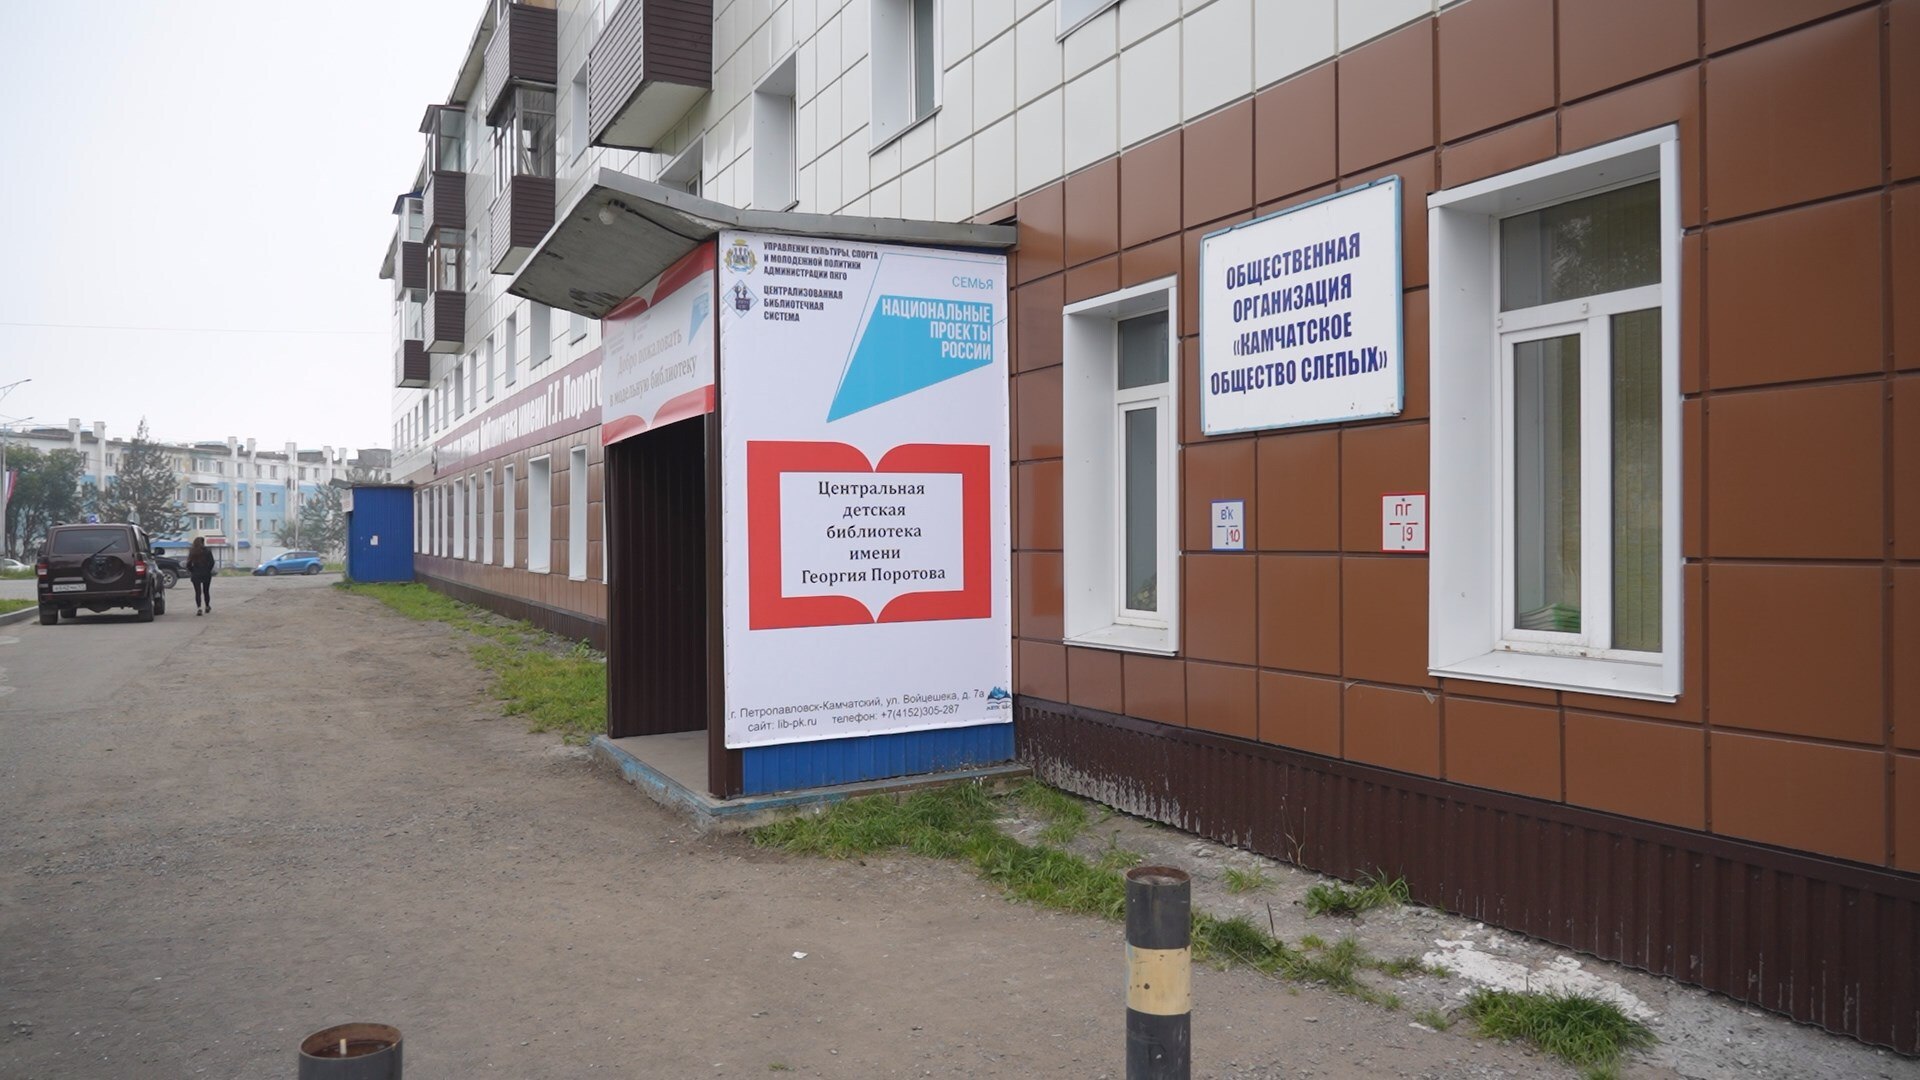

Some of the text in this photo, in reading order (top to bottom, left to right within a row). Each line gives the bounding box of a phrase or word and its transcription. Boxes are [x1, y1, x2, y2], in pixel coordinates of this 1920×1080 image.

[763, 241, 810, 255] УПРАВЛЕНИЕ
[851, 249, 879, 260] СПОРТА
[763, 254, 769, 262] И
[823, 259, 862, 270] ПОЛИТИКИ
[1226, 232, 1361, 290] ОБЩЕСТВЕННАЯ
[763, 266, 848, 281] АДМИНИСТРАЦИИ ПКГО
[952, 276, 994, 290] СЕМЬЯ
[763, 285, 843, 300] ЦЕНТРАЛИЗОВАННАЯ
[1233, 272, 1352, 323] ОРГАНИЗАЦИЯ
[763, 299, 825, 311] БИБЛИОТЕЧНАЯ
[881, 298, 991, 323] НАЦИОНАЛЬНЫЕ
[763, 311, 801, 322] СИСТЕМА
[930, 321, 991, 342] ПРОЕКТЫ
[1233, 311, 1353, 356] «КАМЧАТСКОЕ
[941, 341, 991, 361] РОССИИ
[1211, 346, 1388, 396] ОБЩЕСТВО СЛЕПЫХ»
[818, 481, 925, 498] Центральная
[842, 505, 906, 519] детская
[826, 525, 922, 539] библиотека
[849, 548, 901, 560] имени
[801, 567, 946, 586] Георгия Поротова
[730, 710, 737, 719] г.
[739, 696, 883, 719] Петропавловск-Камчатский,
[886, 697, 900, 706] ул.
[903, 691, 960, 704] Войцешека,
[961, 692, 971, 700] д.
[747, 704, 960, 732] сайт: lib-pk.ru телефон: +7(4152)305-287
